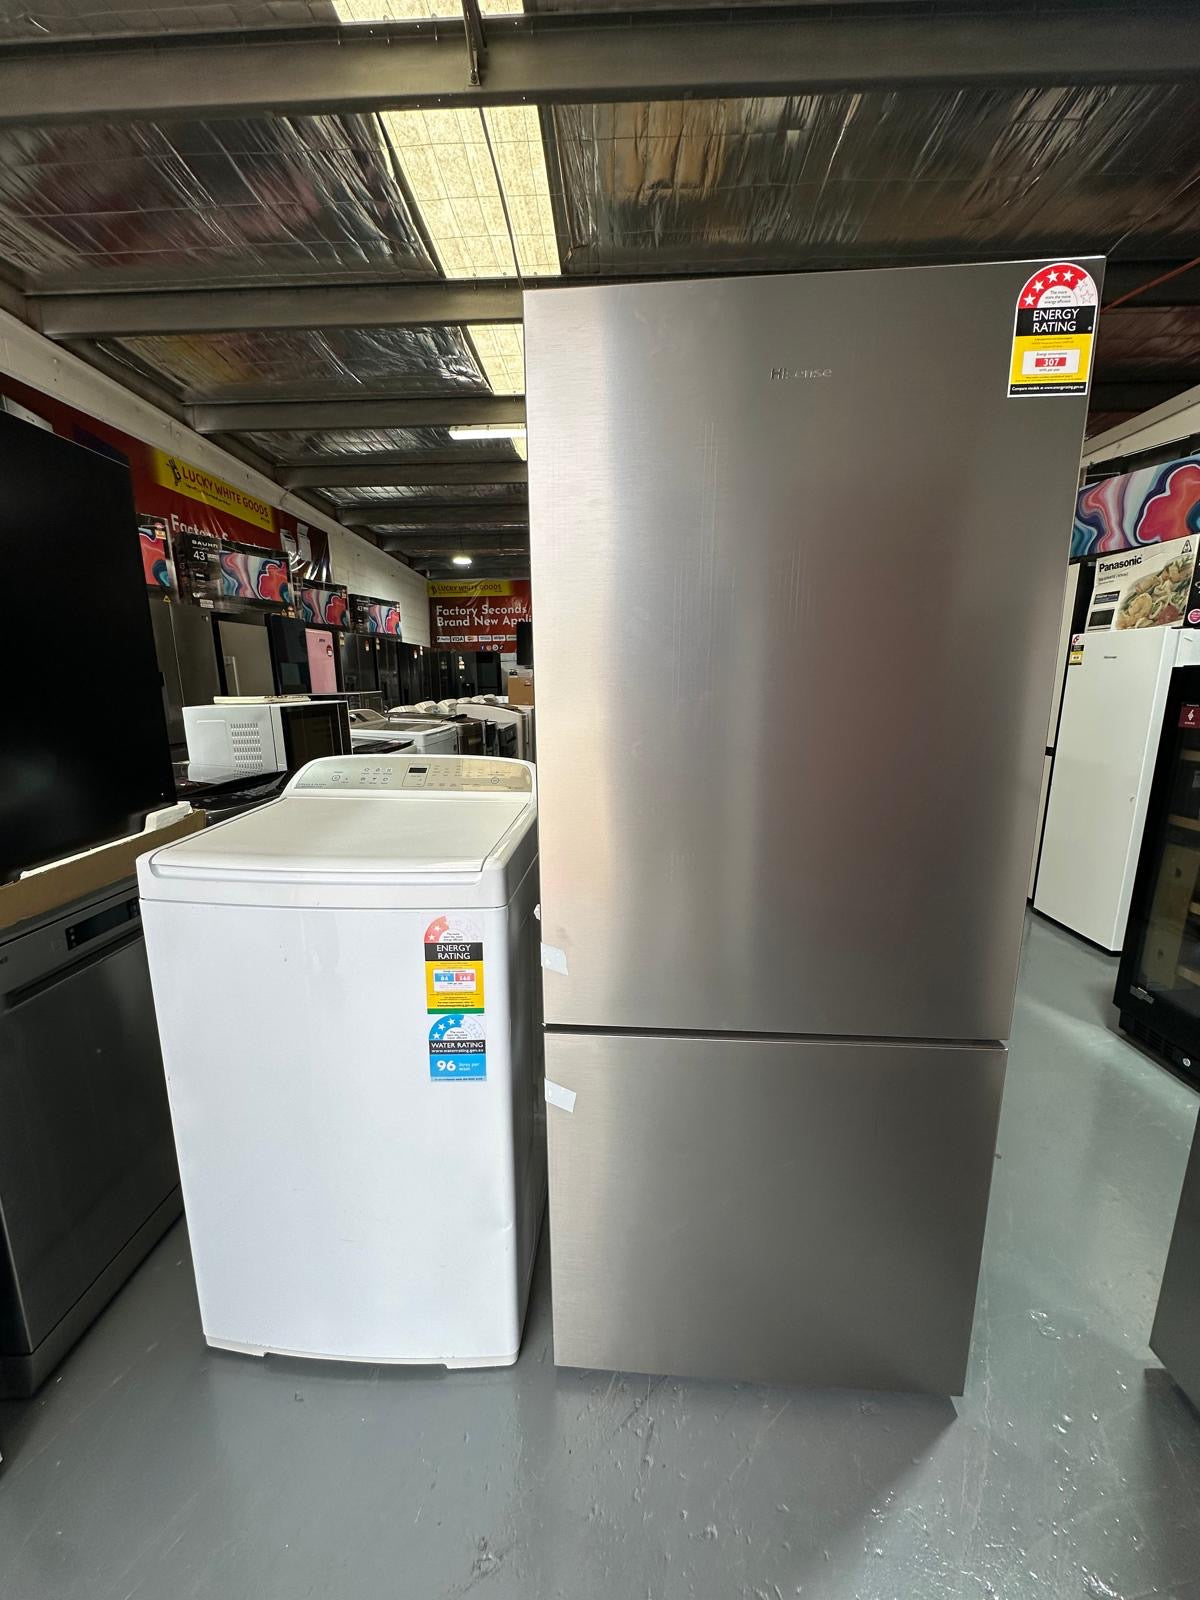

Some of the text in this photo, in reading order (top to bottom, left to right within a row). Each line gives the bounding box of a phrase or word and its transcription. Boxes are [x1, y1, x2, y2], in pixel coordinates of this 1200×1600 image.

[1033, 308, 1080, 321] ENERGY
[1033, 321, 1076, 333] RATING
[1043, 358, 1060, 367] 307
[770, 367, 832, 379] Hiense
[182, 465, 213, 491] LUCKY
[214, 482, 242, 504] WHITE
[242, 495, 269, 517] GOODS
[1099, 555, 1142, 572] Panasonic
[436, 604, 528, 617] Factory Seconds
[436, 615, 470, 627] Brand
[474, 616, 499, 626] New
[436, 944, 471, 952] ENERGY
[437, 952, 471, 960] RATING
[437, 1060, 456, 1072] 96
